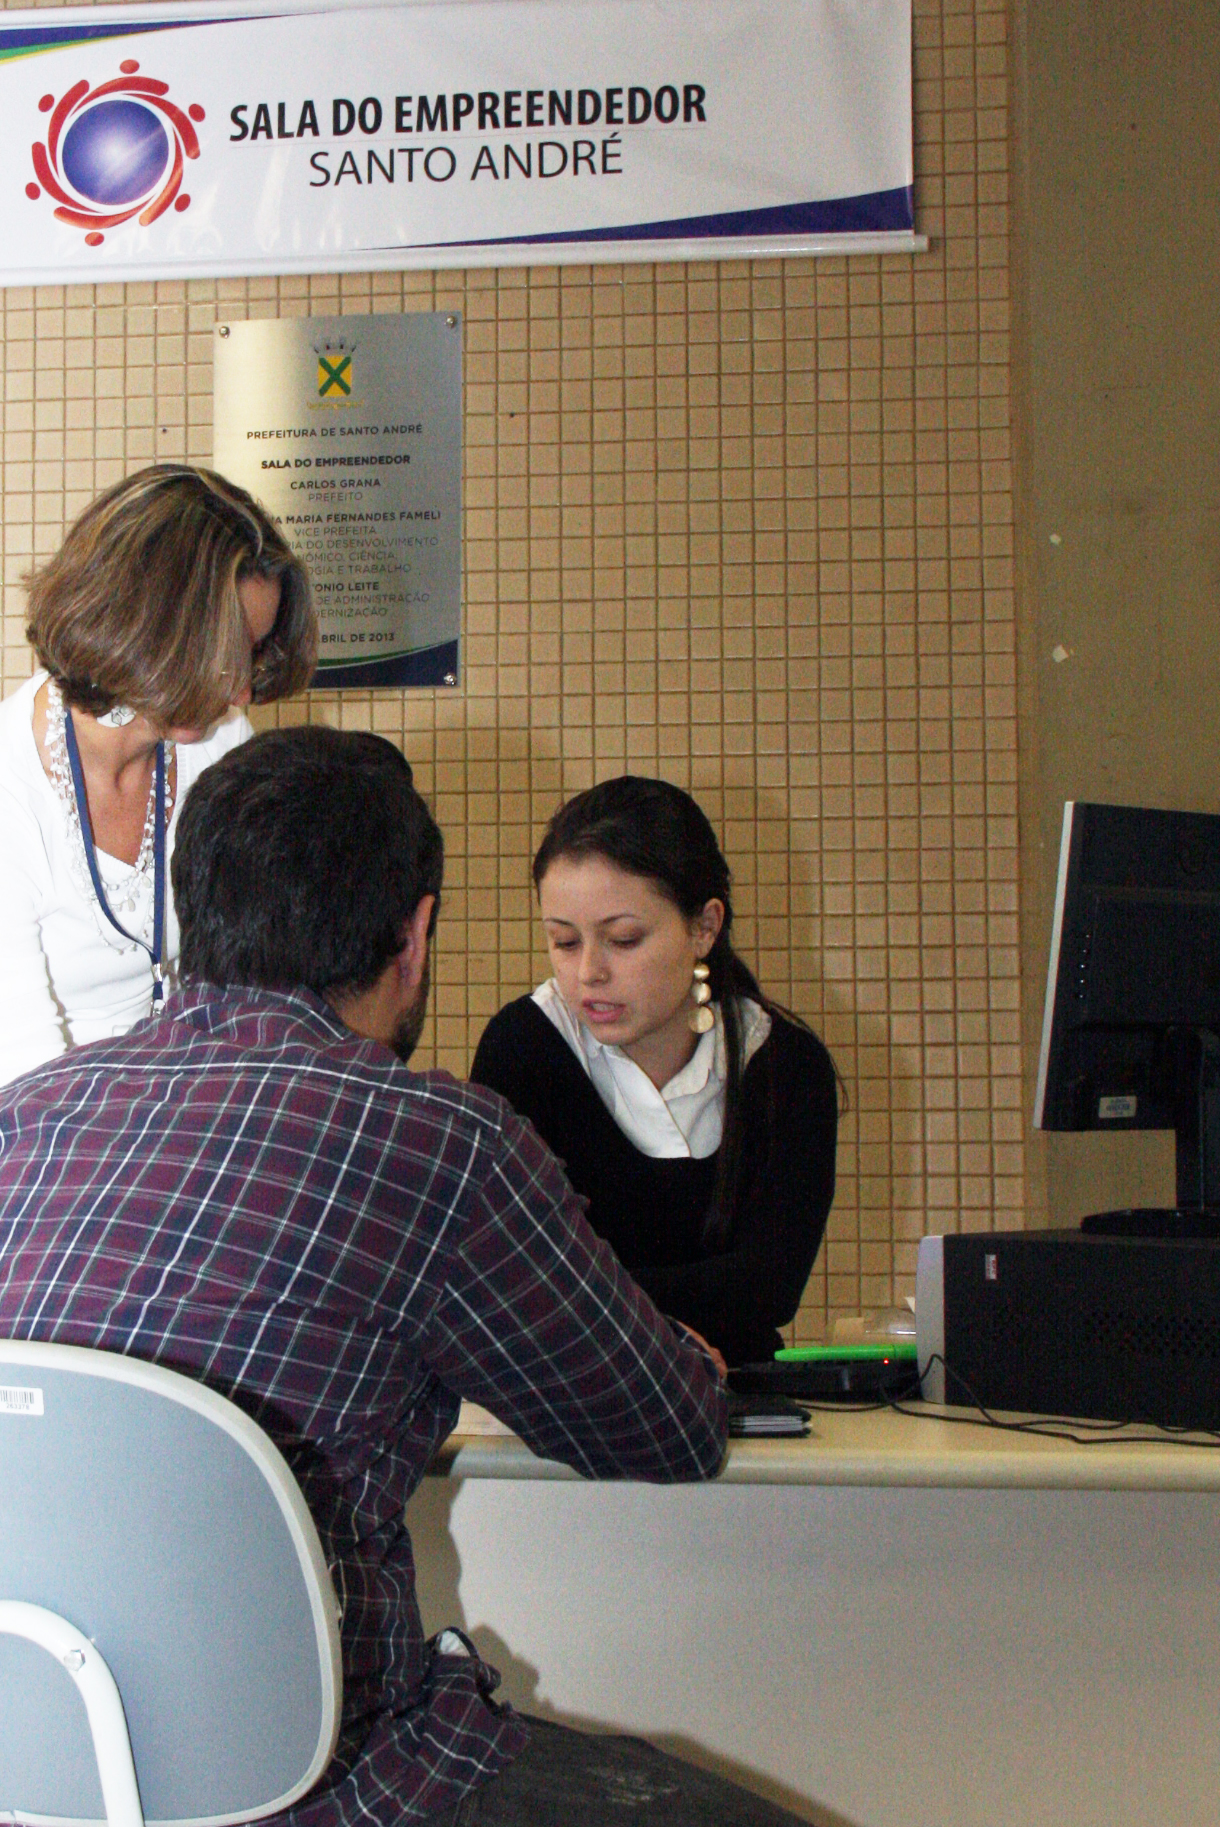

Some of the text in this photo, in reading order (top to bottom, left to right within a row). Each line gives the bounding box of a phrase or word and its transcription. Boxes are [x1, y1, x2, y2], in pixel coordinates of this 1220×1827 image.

[230, 84, 707, 141] SALA DO EMPREENDEDOR
[310, 132, 623, 187] SANTO ANDRÉ
[247, 424, 423, 439] PREFEITURA DE SANTO ANDRÉ
[261, 455, 410, 469] SALA DO EMPREENDEDOR
[290, 478, 381, 490] CARLOS GRANA
[309, 491, 363, 502] PREFEITO
[286, 514, 322, 524] MARIA
[327, 512, 396, 523] FERNANDES
[400, 510, 441, 521] FAMELI
[294, 525, 377, 536] VICE PREFEITA
[306, 540, 323, 550] DO
[328, 536, 439, 549] DESENVOLVIMENTO
[348, 563, 412, 575] TRABALHO
[348, 581, 380, 591] LEITE
[350, 633, 365, 643] DE
[369, 632, 395, 642] 2013
